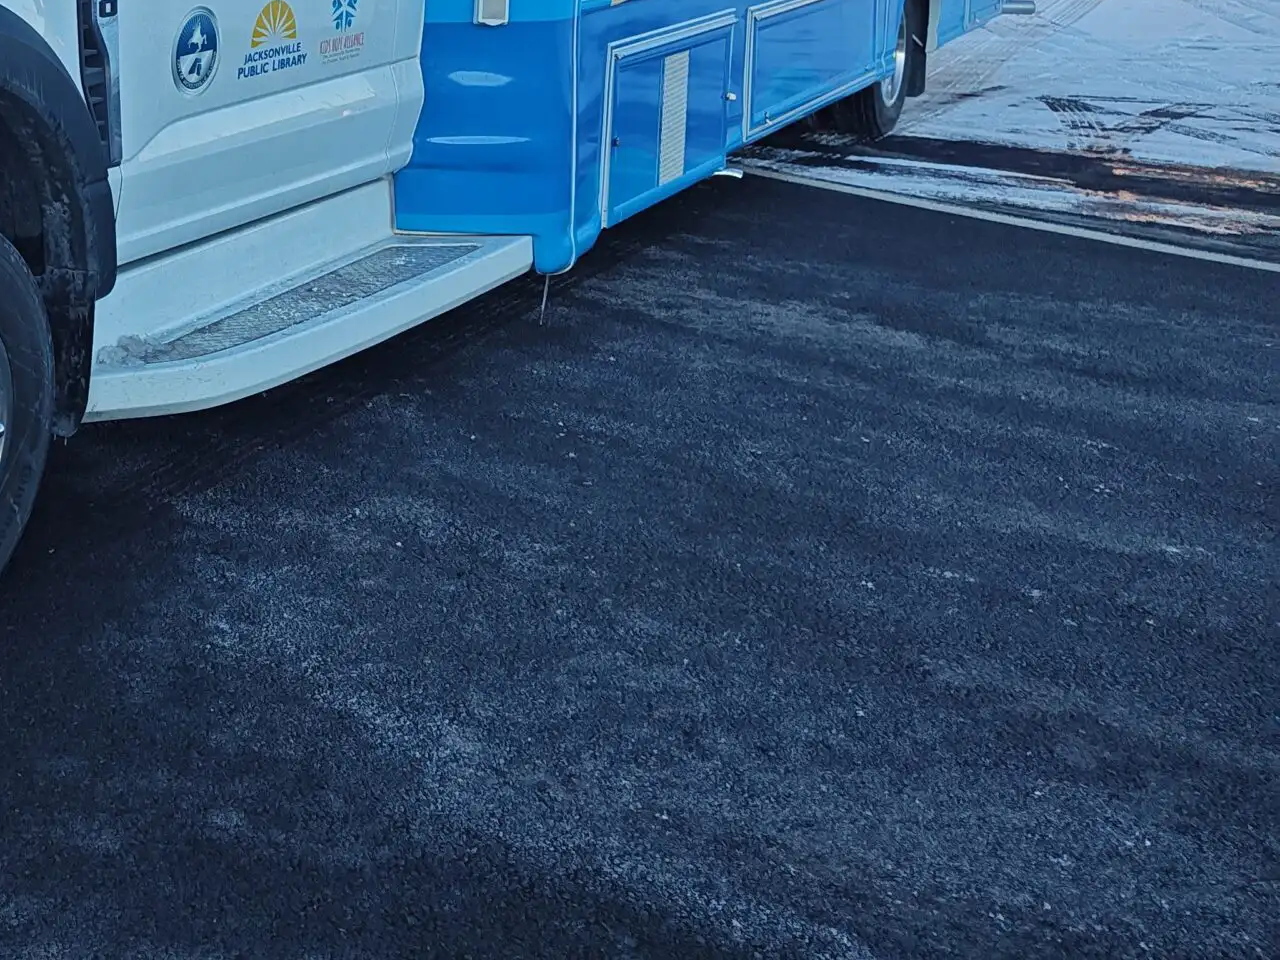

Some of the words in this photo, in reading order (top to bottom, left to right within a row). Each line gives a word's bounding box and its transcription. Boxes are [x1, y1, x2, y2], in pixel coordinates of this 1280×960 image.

[237, 61, 269, 80] PUBLIC
[272, 52, 308, 72] LIBRARY
[243, 41, 302, 66] JACKSONVILLE
